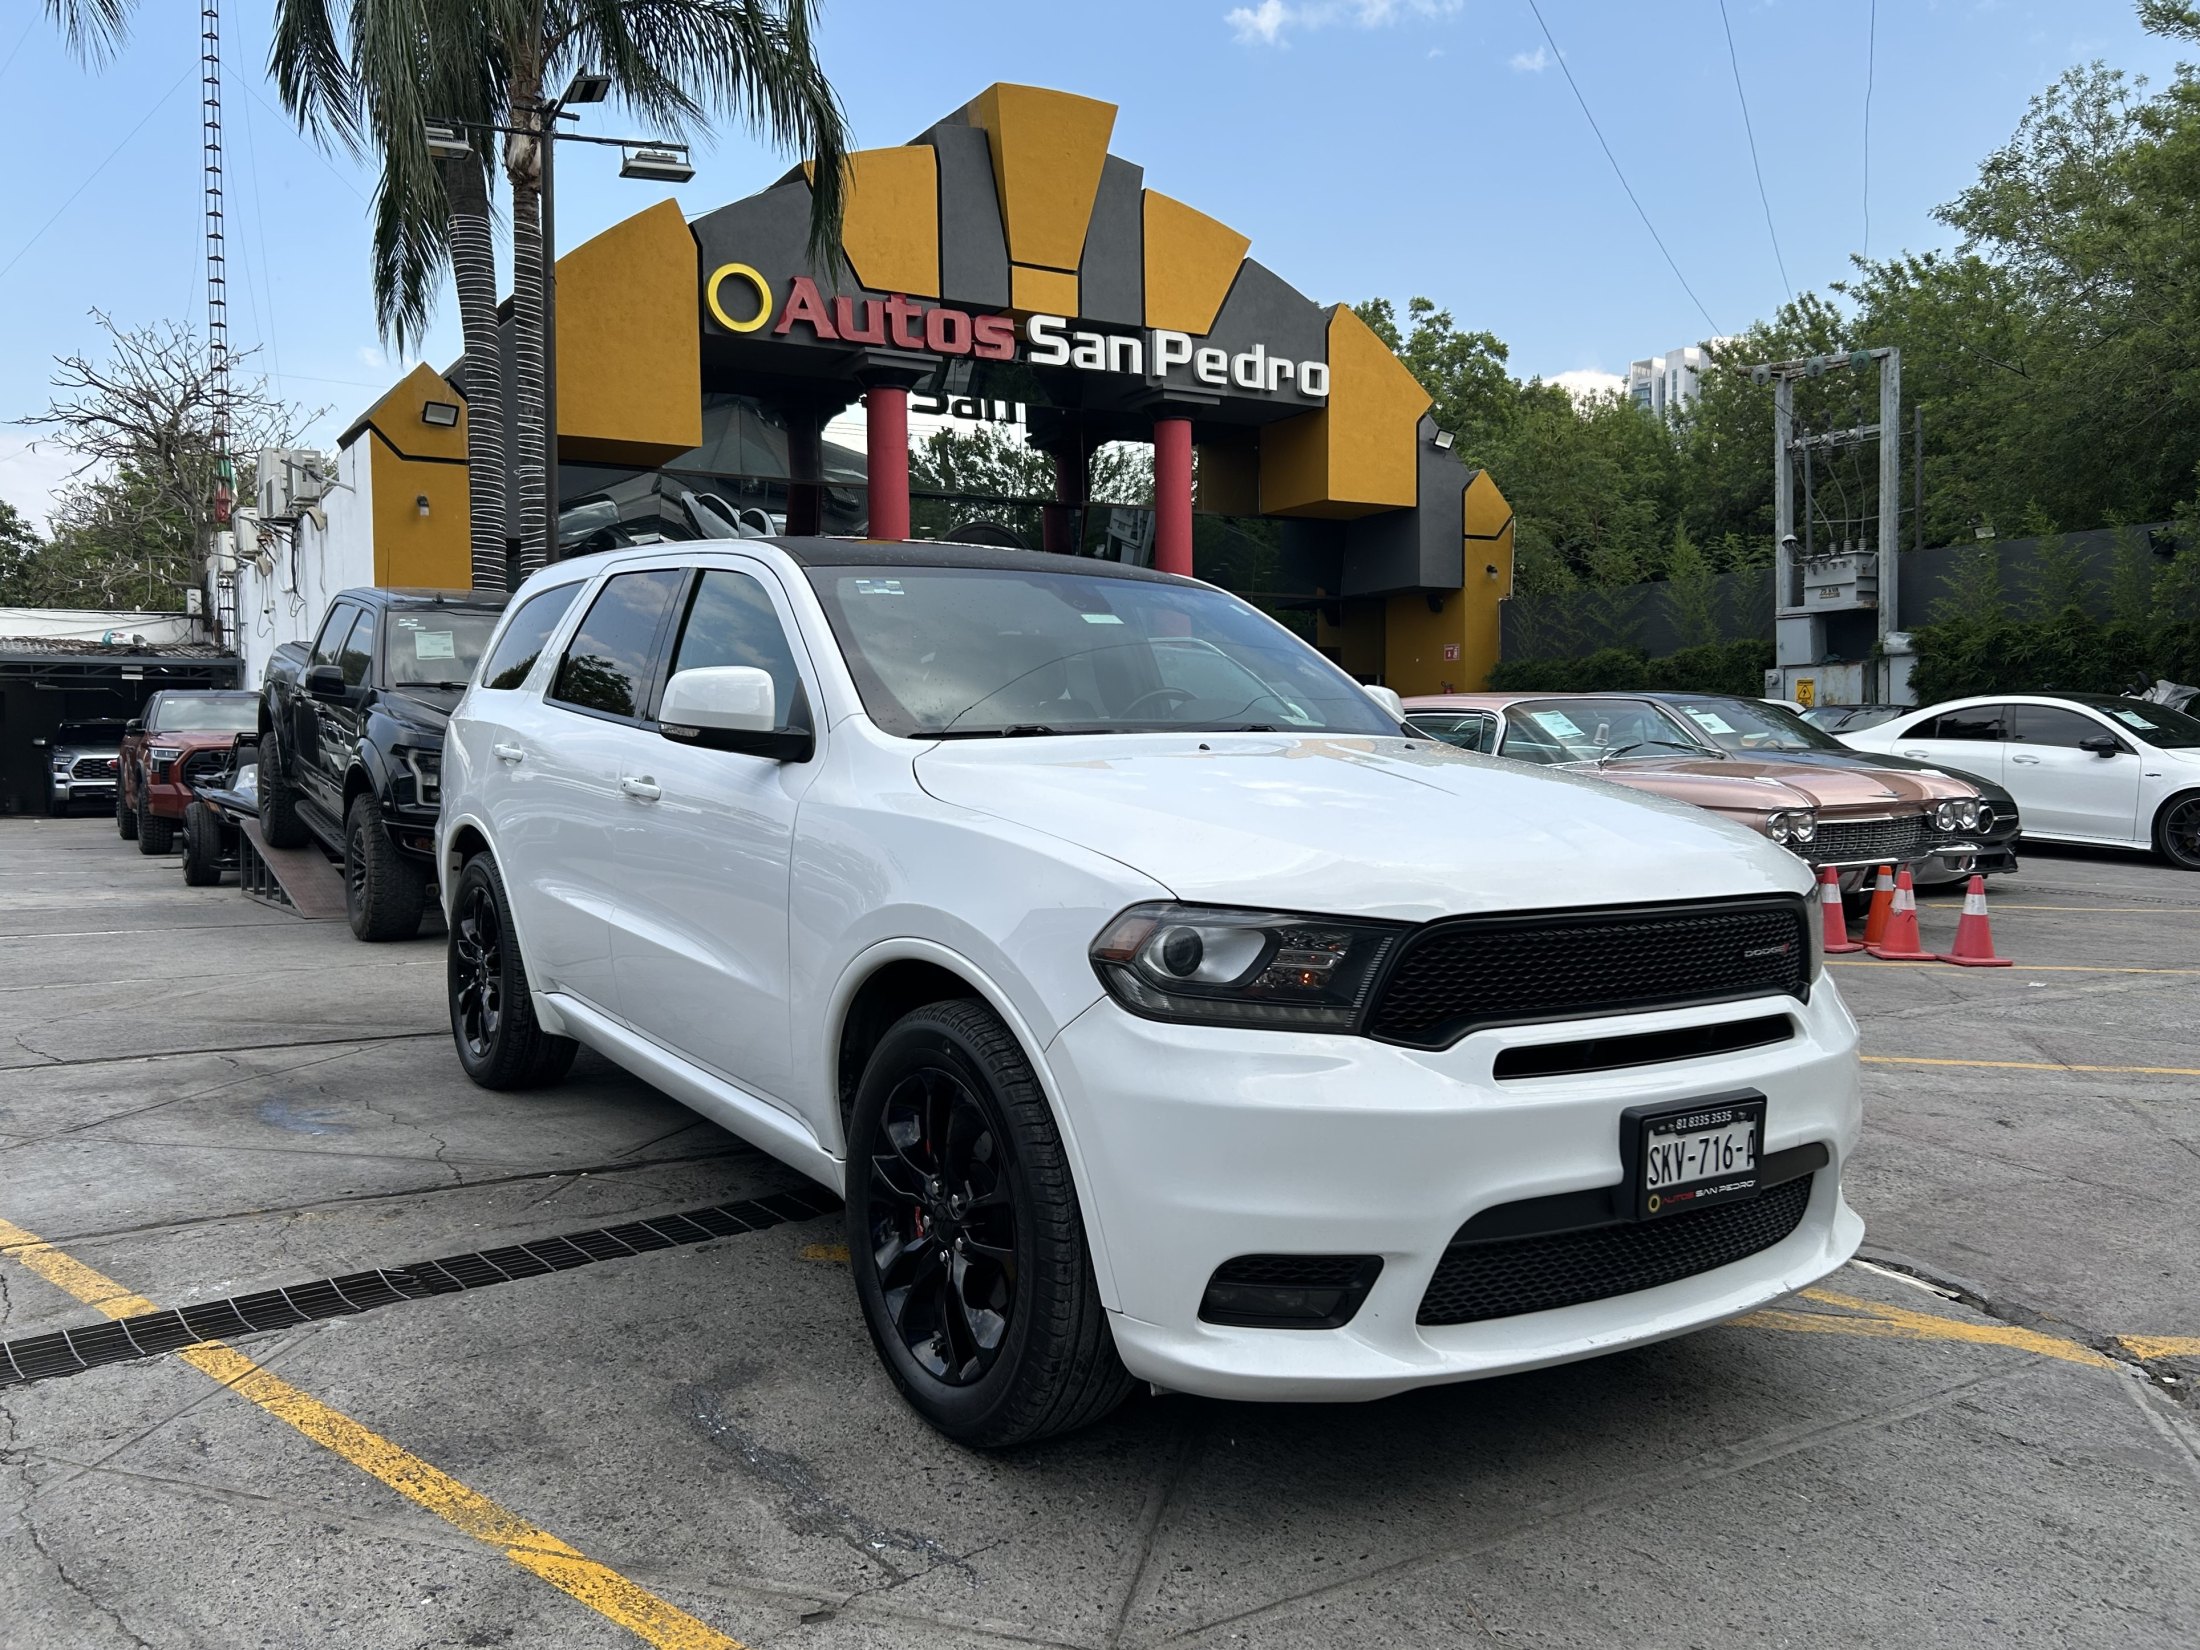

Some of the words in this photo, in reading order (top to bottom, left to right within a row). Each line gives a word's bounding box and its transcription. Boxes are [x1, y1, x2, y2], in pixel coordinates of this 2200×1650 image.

[774, 276, 1015, 361] Autos
[1026, 314, 1143, 374] San
[1151, 329, 1330, 397] Pedro
[1744, 946, 1784, 957] DODGE
[1676, 1118, 1687, 1129] 81
[1688, 1114, 1710, 1127] 8335
[1711, 1110, 1732, 1123] 3535
[1696, 1187, 1718, 1197] SAN
[1719, 1181, 1754, 1192] PEDRO
